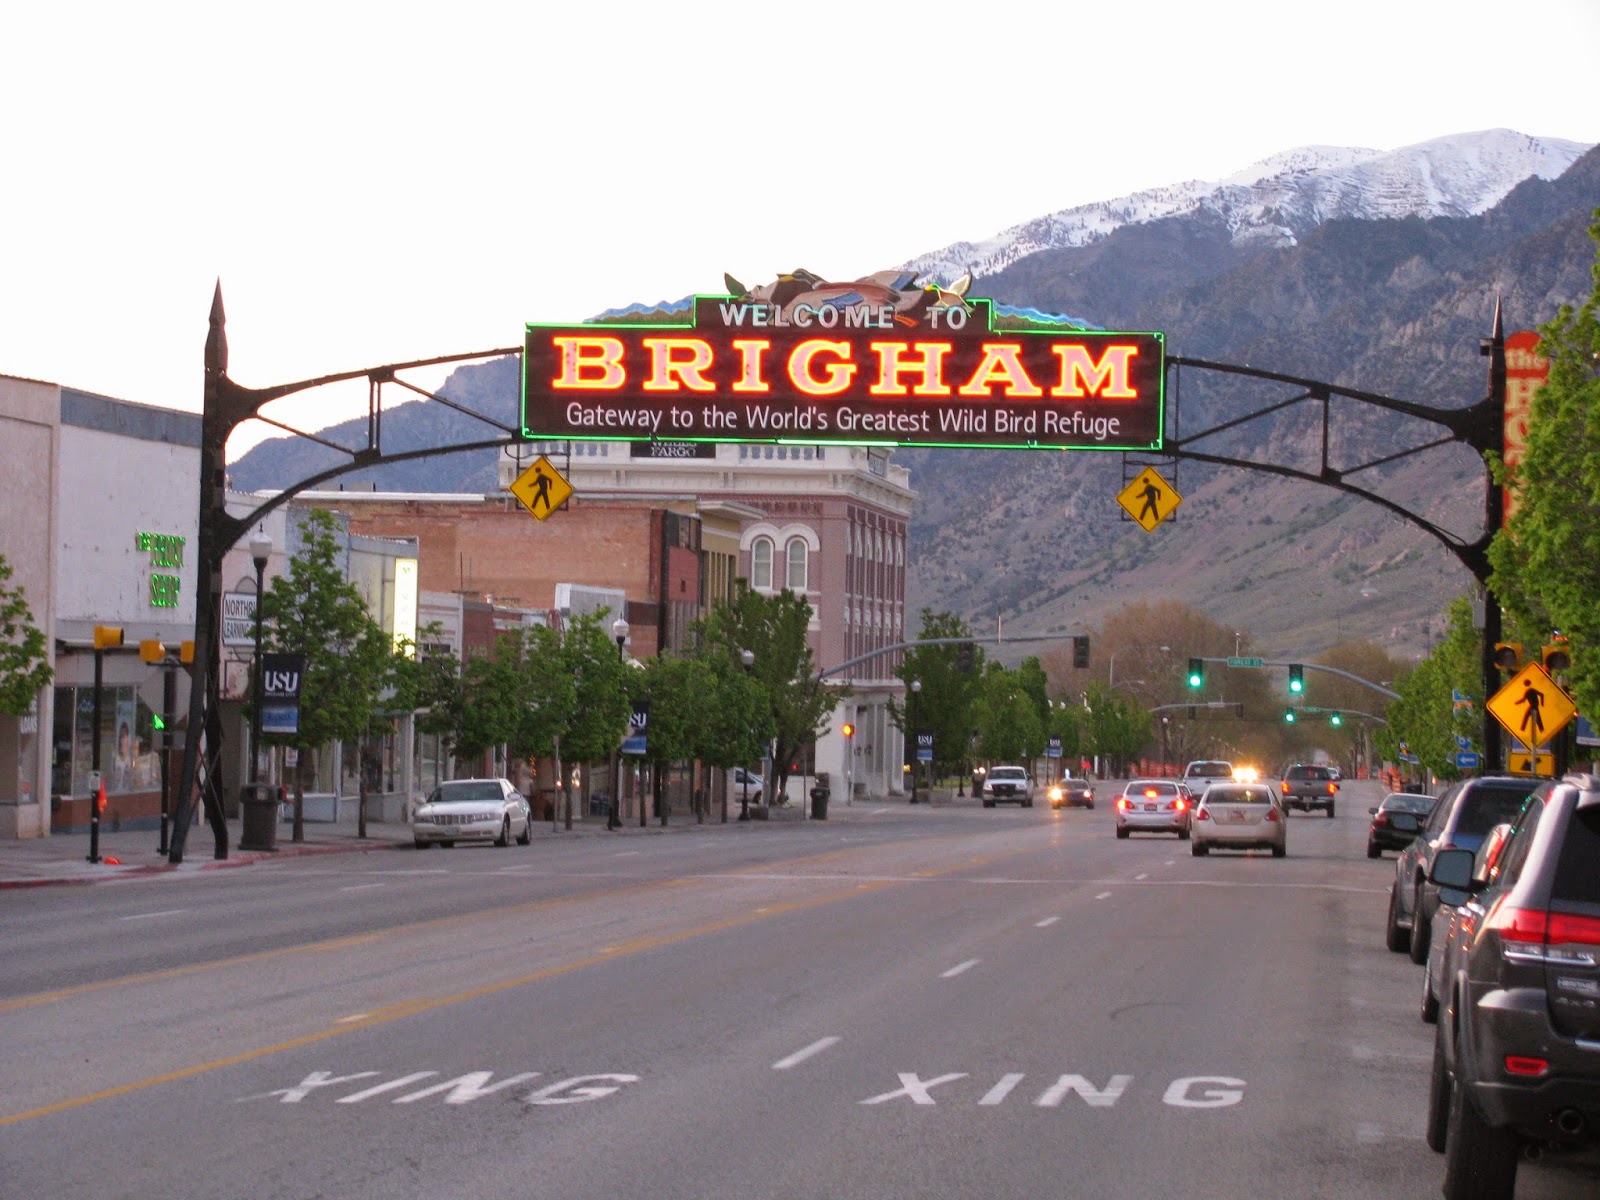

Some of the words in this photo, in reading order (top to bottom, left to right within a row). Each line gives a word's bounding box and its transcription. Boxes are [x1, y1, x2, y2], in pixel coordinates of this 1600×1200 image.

[719, 303, 895, 329] WELCOME
[926, 305, 968, 330] TO
[551, 336, 1139, 399] BRIGHAM
[566, 402, 663, 432] Gateway
[671, 406, 694, 428] to
[703, 405, 740, 429] the
[746, 405, 829, 431] World's
[836, 407, 930, 432] Greatest
[939, 409, 987, 433] Wild
[995, 410, 1036, 434] Bird
[1044, 411, 1120, 441] Refuge
[651, 446, 697, 457] FARGO
[264, 670, 298, 692] USU
[855, 1072, 1248, 1108] XING
